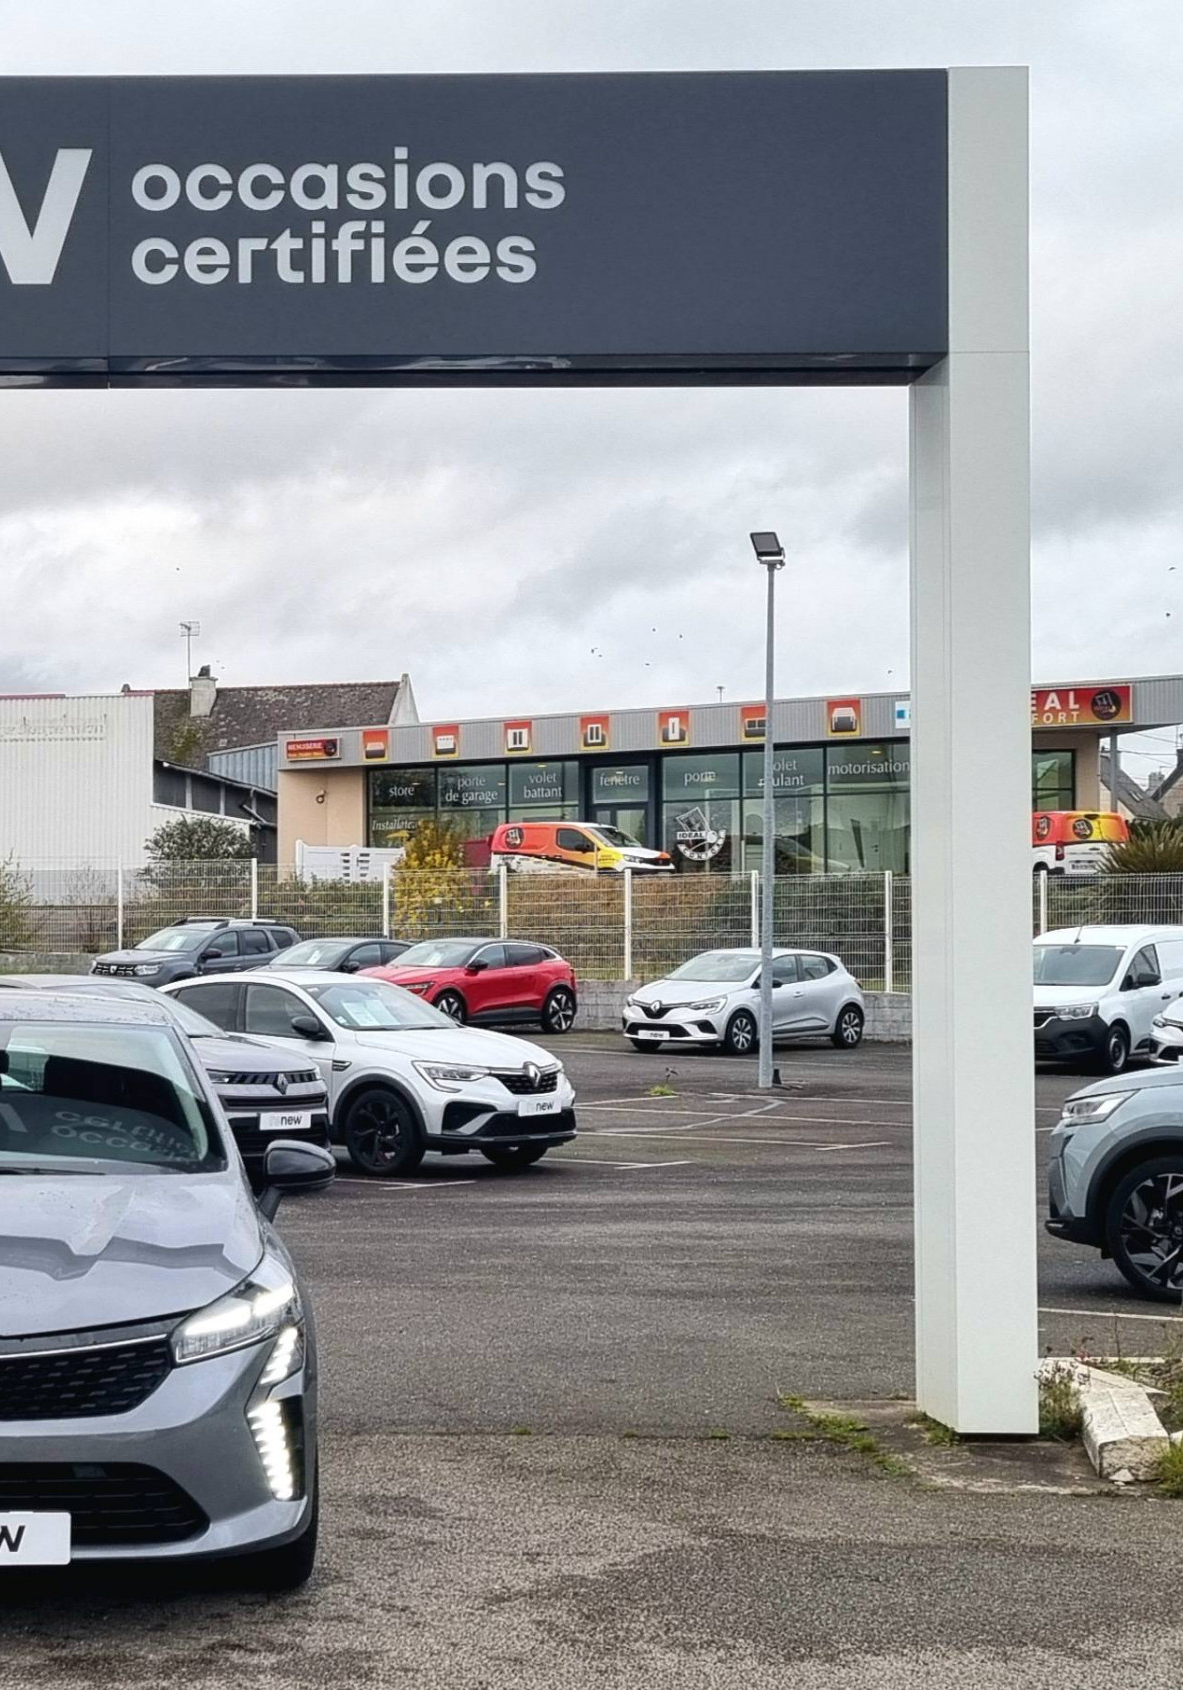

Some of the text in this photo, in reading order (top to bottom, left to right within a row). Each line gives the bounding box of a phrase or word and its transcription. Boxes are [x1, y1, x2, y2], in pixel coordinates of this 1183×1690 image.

[131, 146, 566, 211] occasions
[131, 220, 537, 285] certifiées
[772, 758, 797, 771] olet
[828, 759, 910, 776] motorisation
[457, 775, 486, 789] porte
[529, 771, 556, 784] volet
[684, 771, 716, 787] porte
[389, 785, 415, 797] store
[445, 790, 498, 805] de garage
[524, 786, 562, 799] battant
